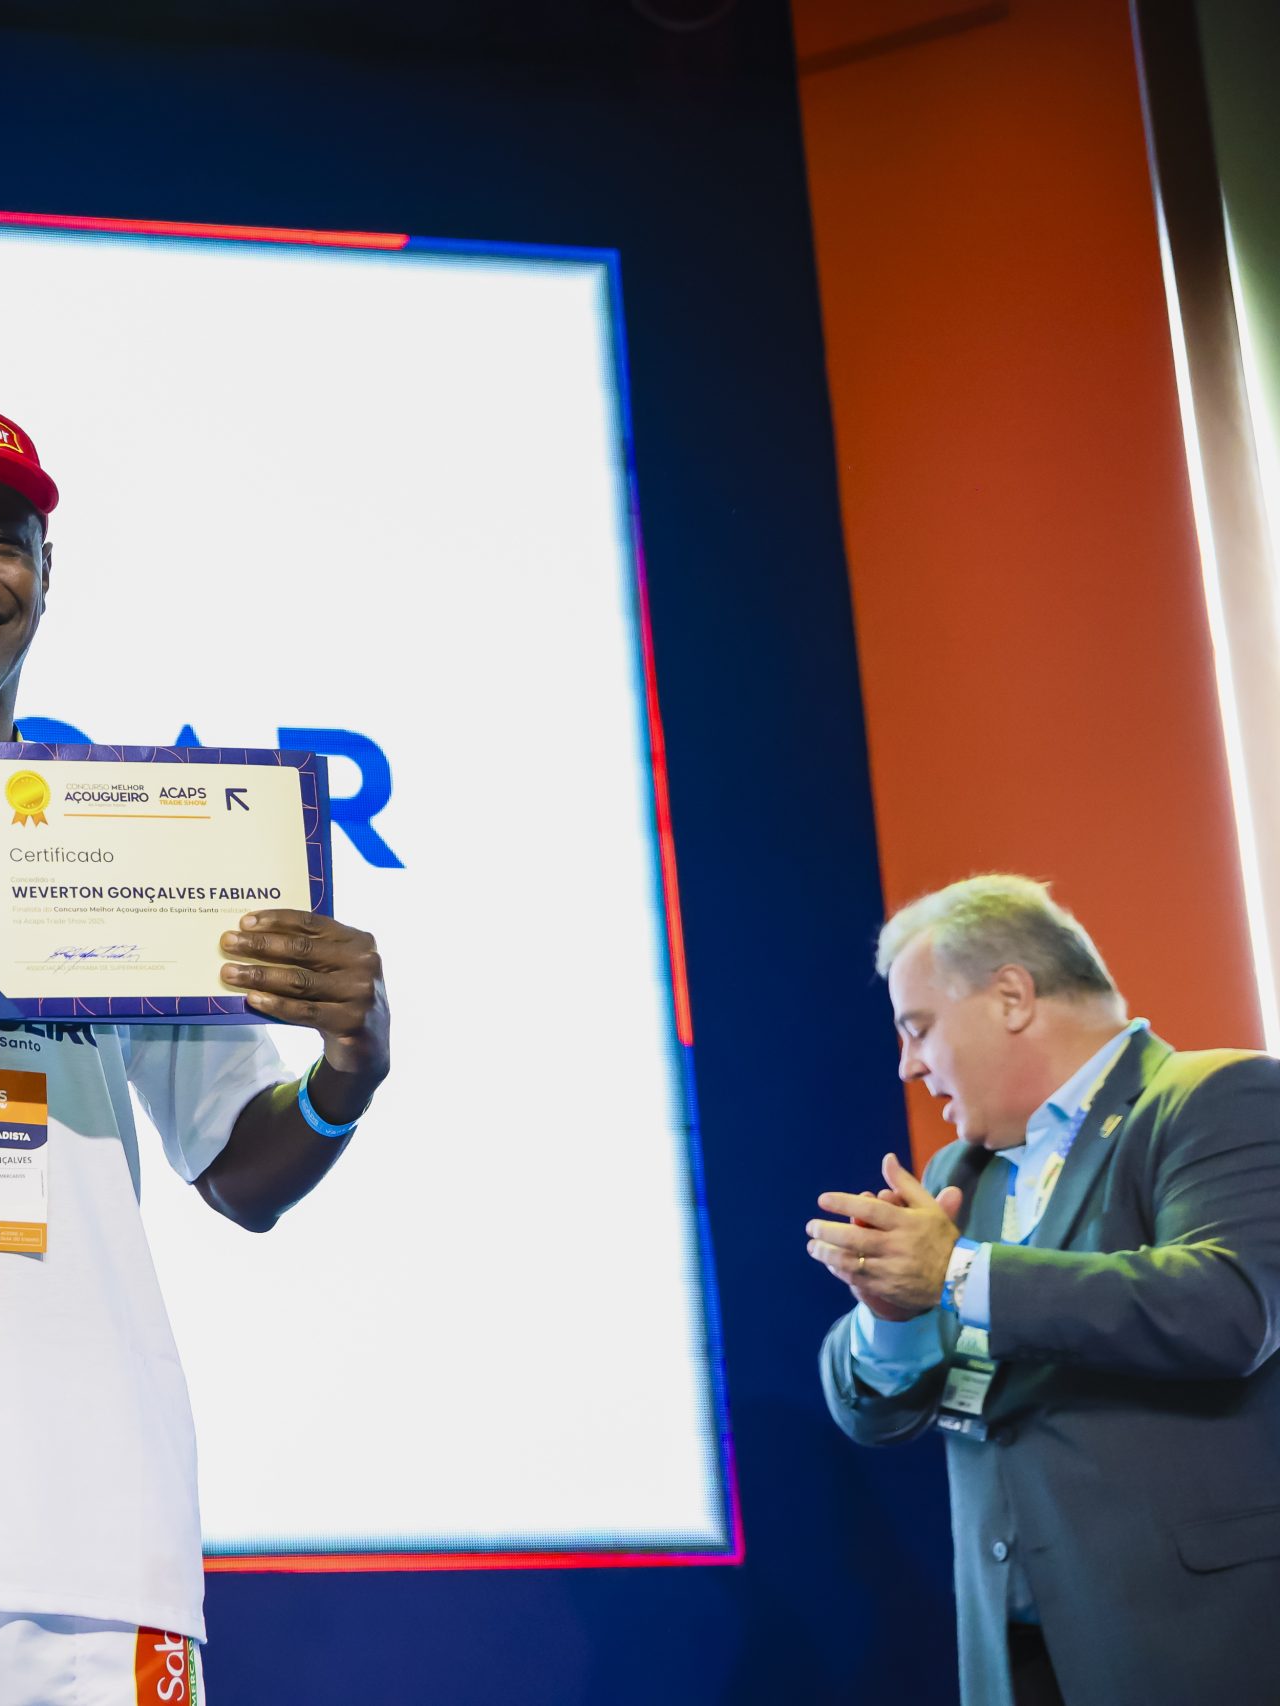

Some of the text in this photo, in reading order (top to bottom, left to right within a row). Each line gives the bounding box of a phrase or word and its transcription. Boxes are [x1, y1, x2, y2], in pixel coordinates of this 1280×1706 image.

[64, 791, 149, 804] AÇOUGUEIRO
[159, 787, 207, 799] ACAPS
[9, 847, 114, 862] Certificado
[12, 886, 281, 903] WEVERTON GONÇALVES FABIANO
[116, 906, 157, 915] Açougueiro
[0, 1036, 42, 1052] Santo
[153, 1630, 185, 1702] Sab
